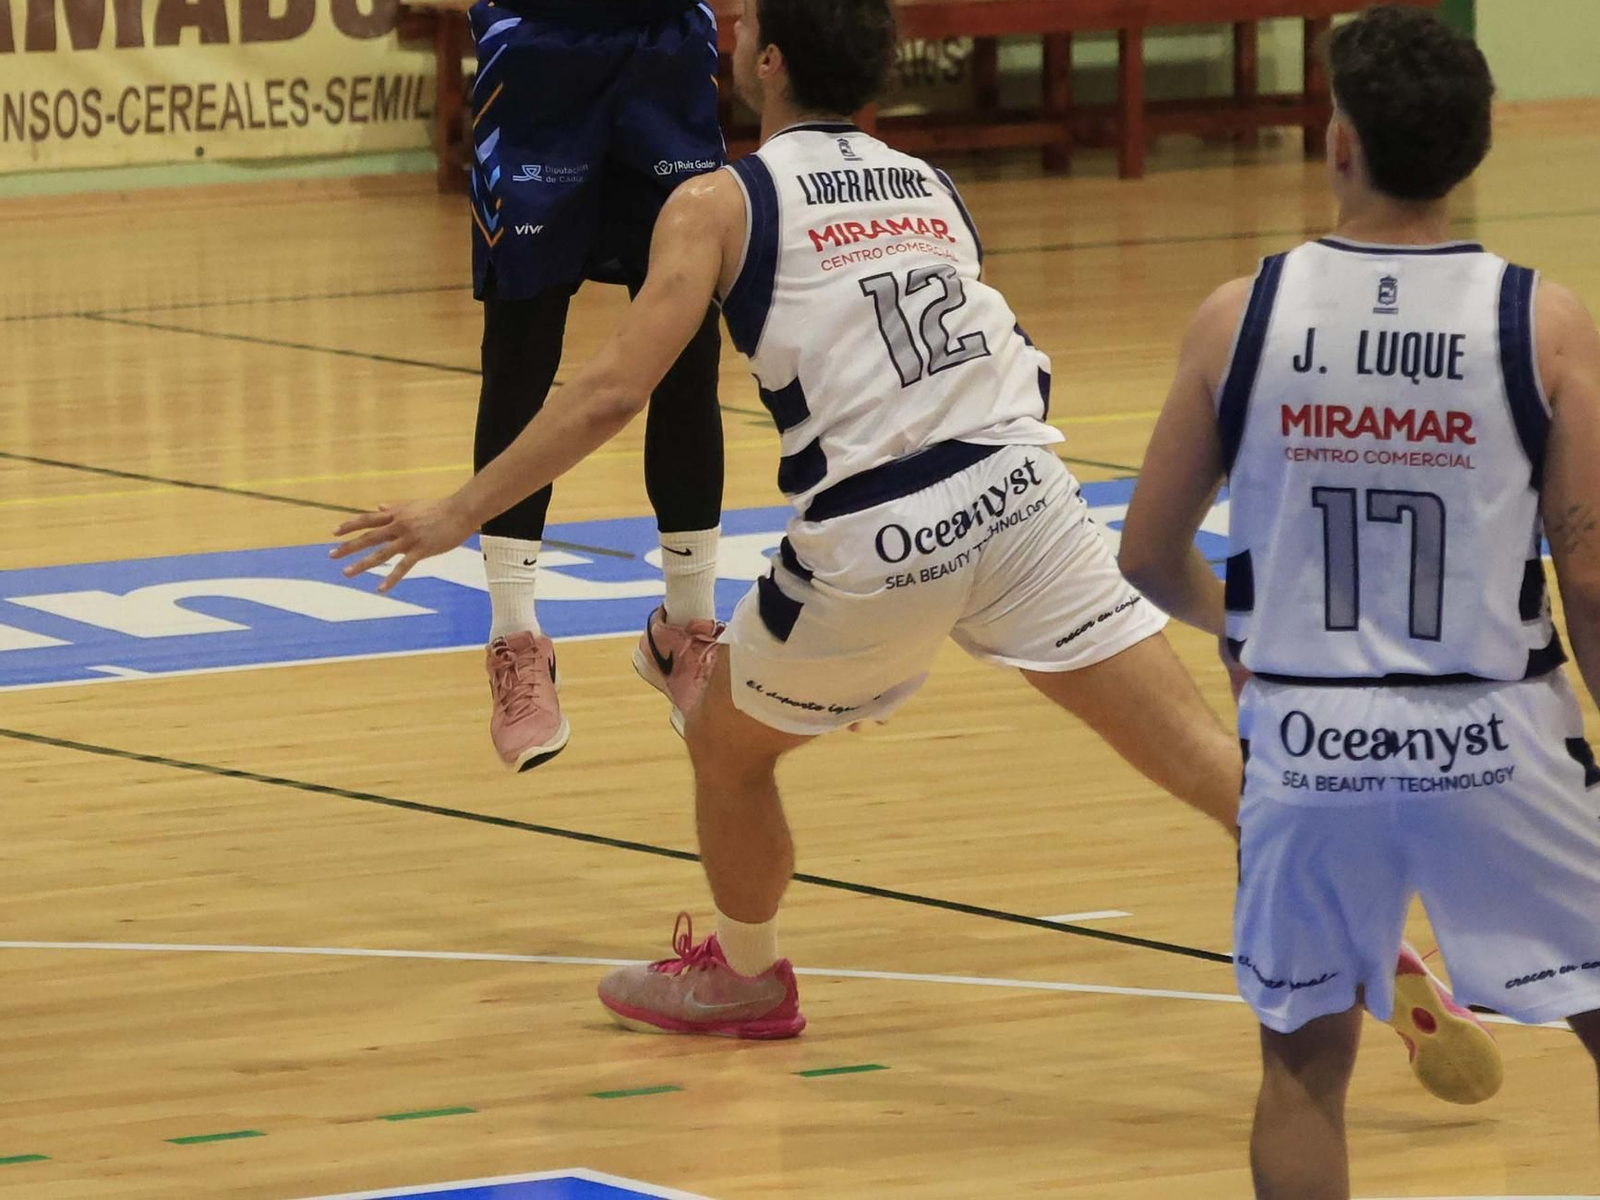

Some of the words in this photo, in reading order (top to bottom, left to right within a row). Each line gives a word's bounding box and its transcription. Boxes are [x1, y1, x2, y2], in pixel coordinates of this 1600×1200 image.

[796, 166, 932, 206] LIBERATORE
[807, 216, 956, 252] MIRAMAR
[820, 247, 884, 272] CENTRO
[858, 263, 992, 389] 12
[1292, 326, 1328, 375] J.
[1356, 329, 1466, 385] LUQUE
[1280, 403, 1477, 445] MIRAMAR
[1284, 446, 1361, 465] CENTRO
[1362, 450, 1476, 470] COMERCIAL
[874, 455, 1043, 564] Oceanyst
[885, 572, 917, 590] SEA
[919, 550, 971, 583] BEAUTY
[1311, 486, 1447, 642] 17
[1279, 710, 1510, 773] Oceanyst
[1281, 769, 1310, 790] SEA
[1315, 775, 1386, 792] BEAUTY
[1391, 765, 1515, 793] TECHNOLOGY
